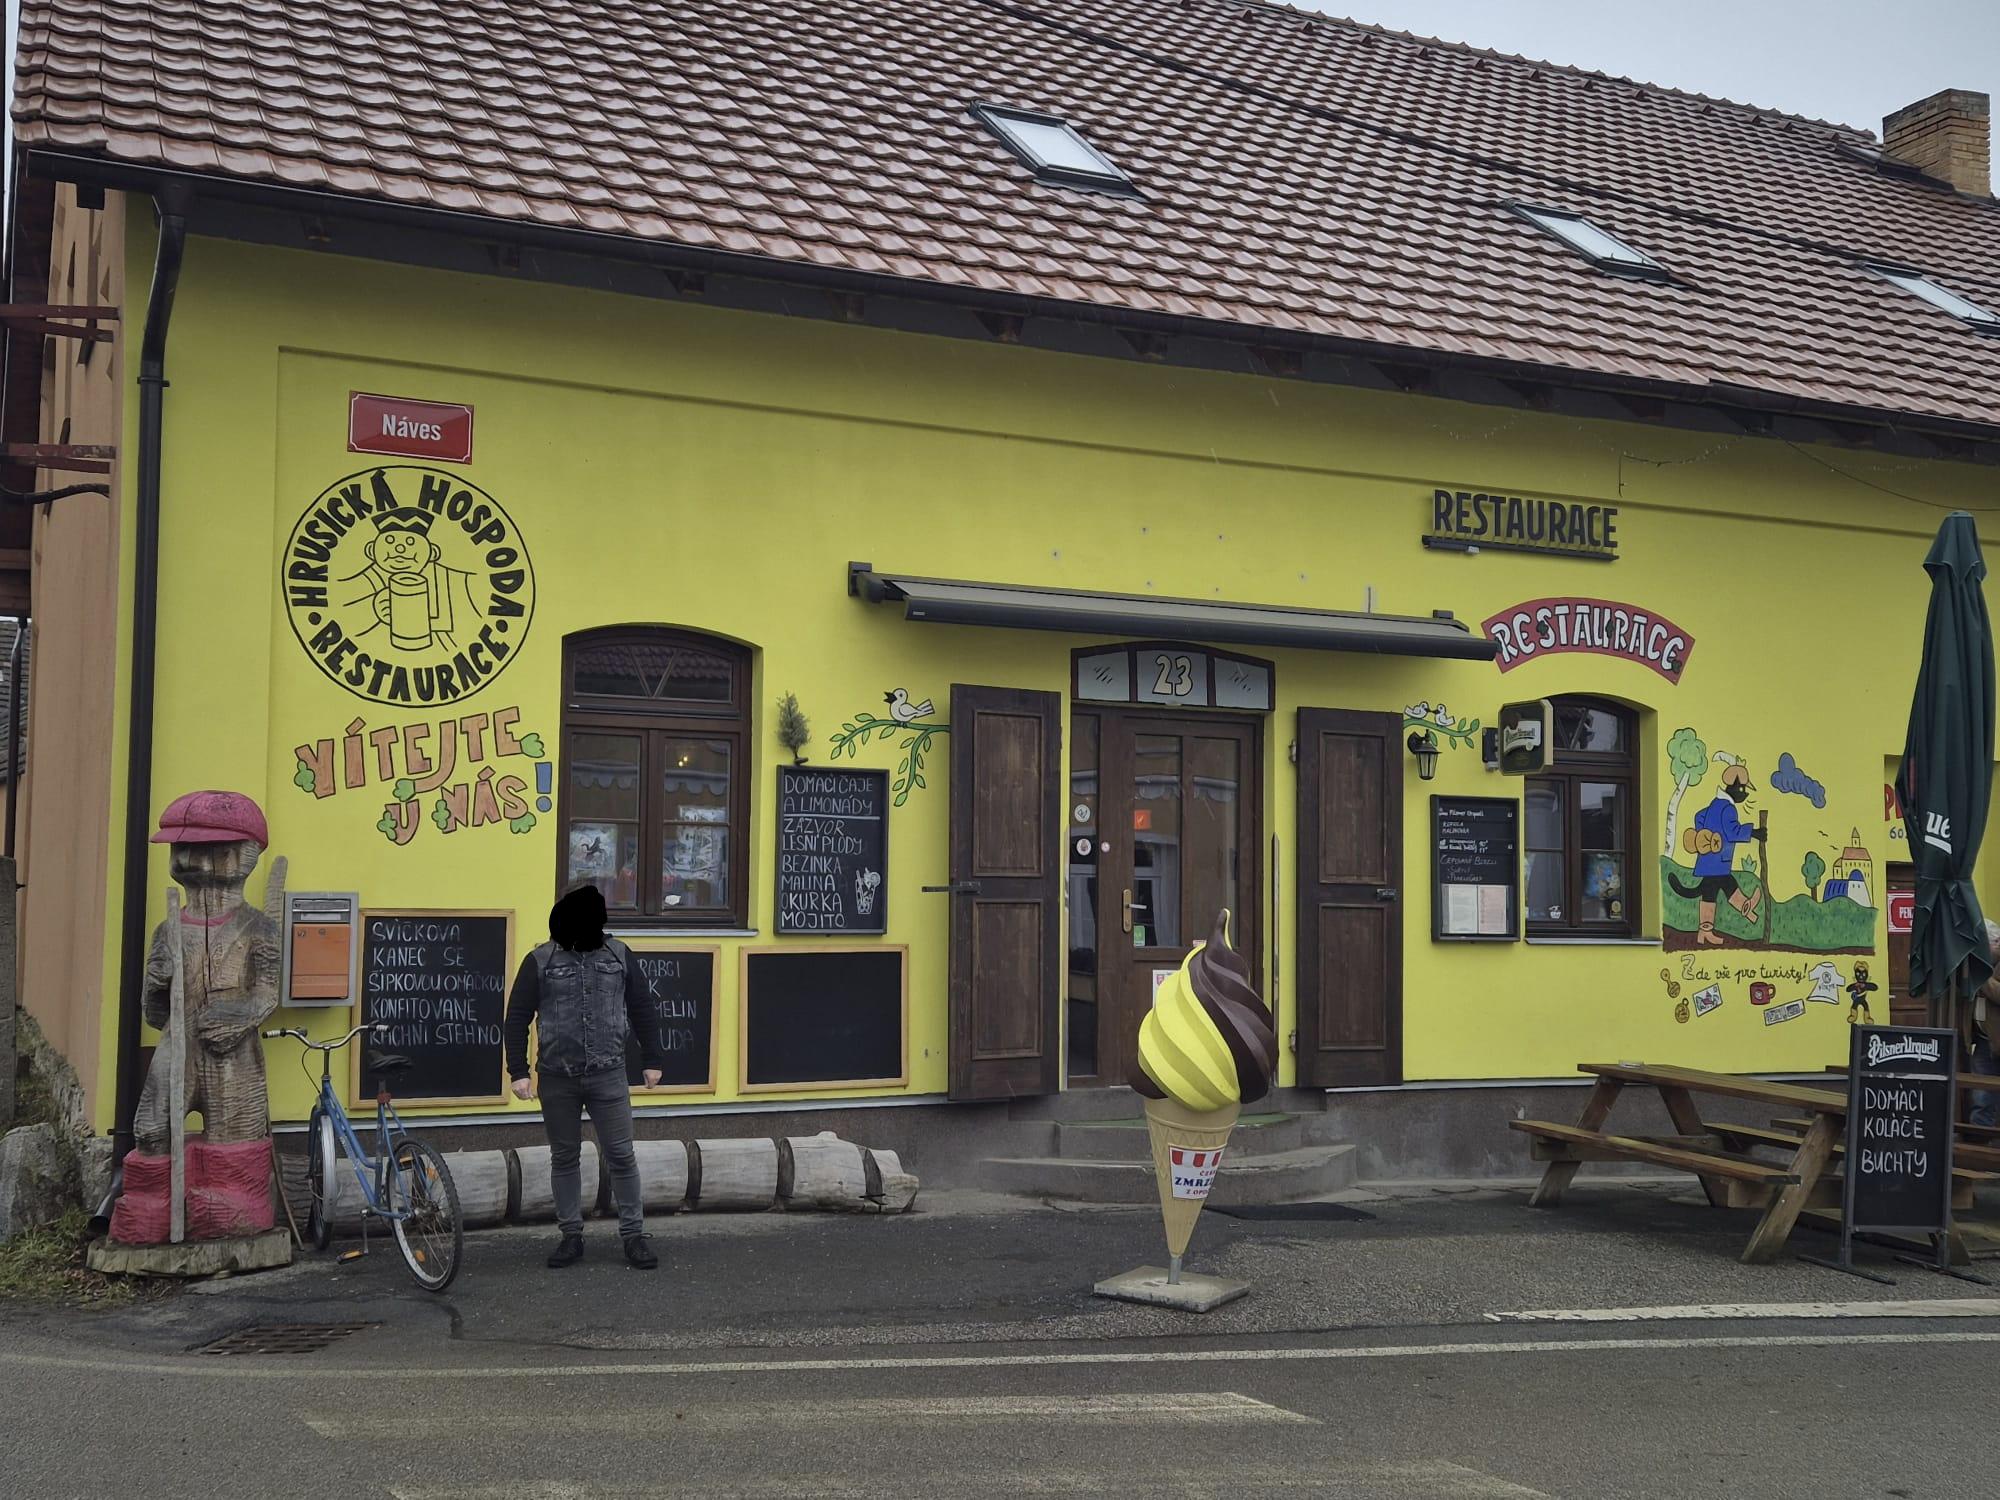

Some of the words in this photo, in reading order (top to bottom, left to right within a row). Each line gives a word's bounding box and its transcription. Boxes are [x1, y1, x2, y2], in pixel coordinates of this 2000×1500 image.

[382, 413, 442, 441] Náves
[1433, 489, 1618, 548] RESTAURACE
[288, 468, 399, 607] HRUSICKÁ
[418, 474, 525, 617] HOSPODA
[1491, 603, 1684, 671] RESTAURACE
[309, 619, 510, 702] RESTAURACE
[1152, 654, 1194, 697] 23
[294, 706, 528, 799] VÍTEJTE
[838, 774, 873, 794] ČAJE
[784, 797, 795, 813] A
[800, 795, 872, 815] LIMONÁDY
[380, 799, 420, 846] U
[822, 835, 862, 854] PLODY
[782, 855, 842, 874] BEZINKA
[781, 874, 836, 891] MALINA
[781, 892, 842, 912] OKURKA
[782, 912, 845, 928] MOJITO
[373, 946, 426, 967] KANEC
[443, 946, 465, 967] SE
[1680, 953, 1711, 981] Zde
[1715, 966, 1732, 981] vše
[1735, 968, 1757, 984] pro
[1760, 963, 1808, 984] turisty!
[434, 1023, 501, 1045] STEHNO
[1867, 1034, 1905, 1067] Pilsner
[1863, 1113, 1925, 1140] KOLÁČE
[1861, 1148, 1928, 1178] BUCHTY
